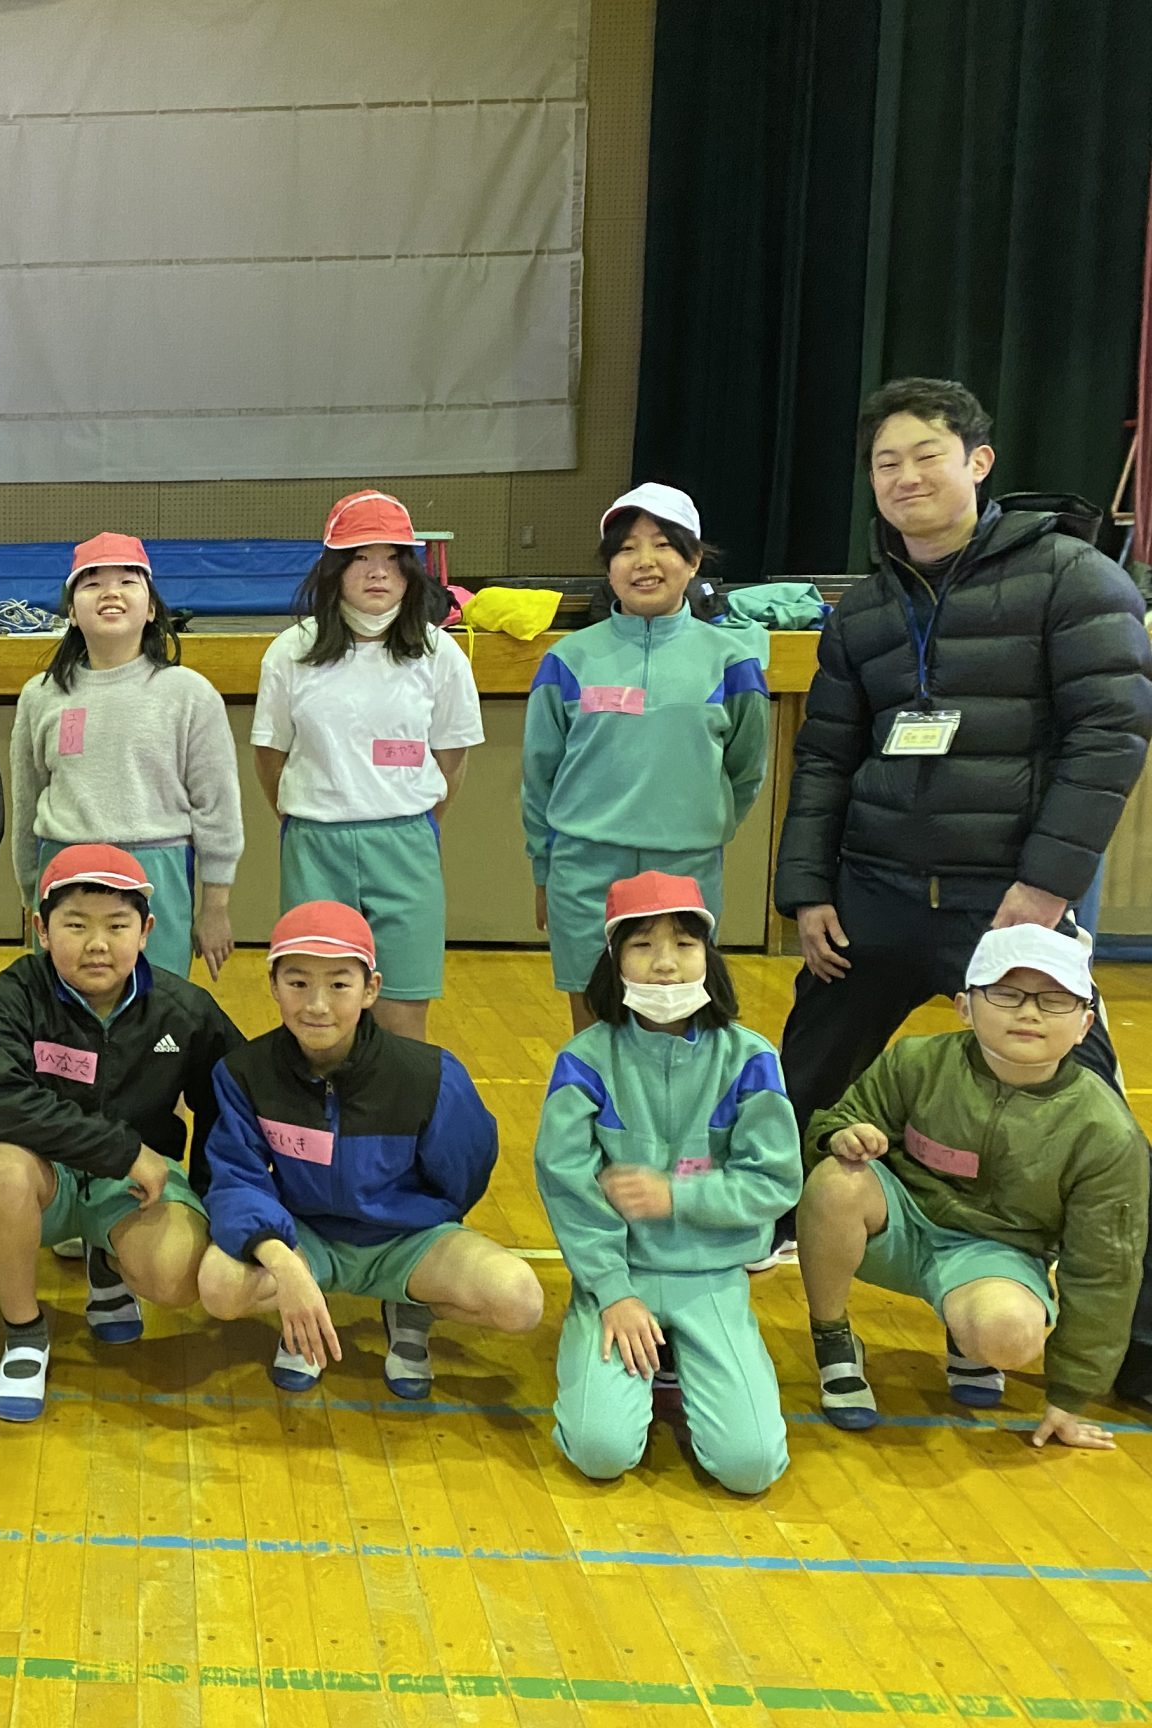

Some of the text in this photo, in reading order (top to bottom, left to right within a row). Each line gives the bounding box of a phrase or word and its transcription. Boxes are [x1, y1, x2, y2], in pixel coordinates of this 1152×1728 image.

[39, 1048, 90, 1076] ひなた
[266, 1129, 307, 1156] だいき
